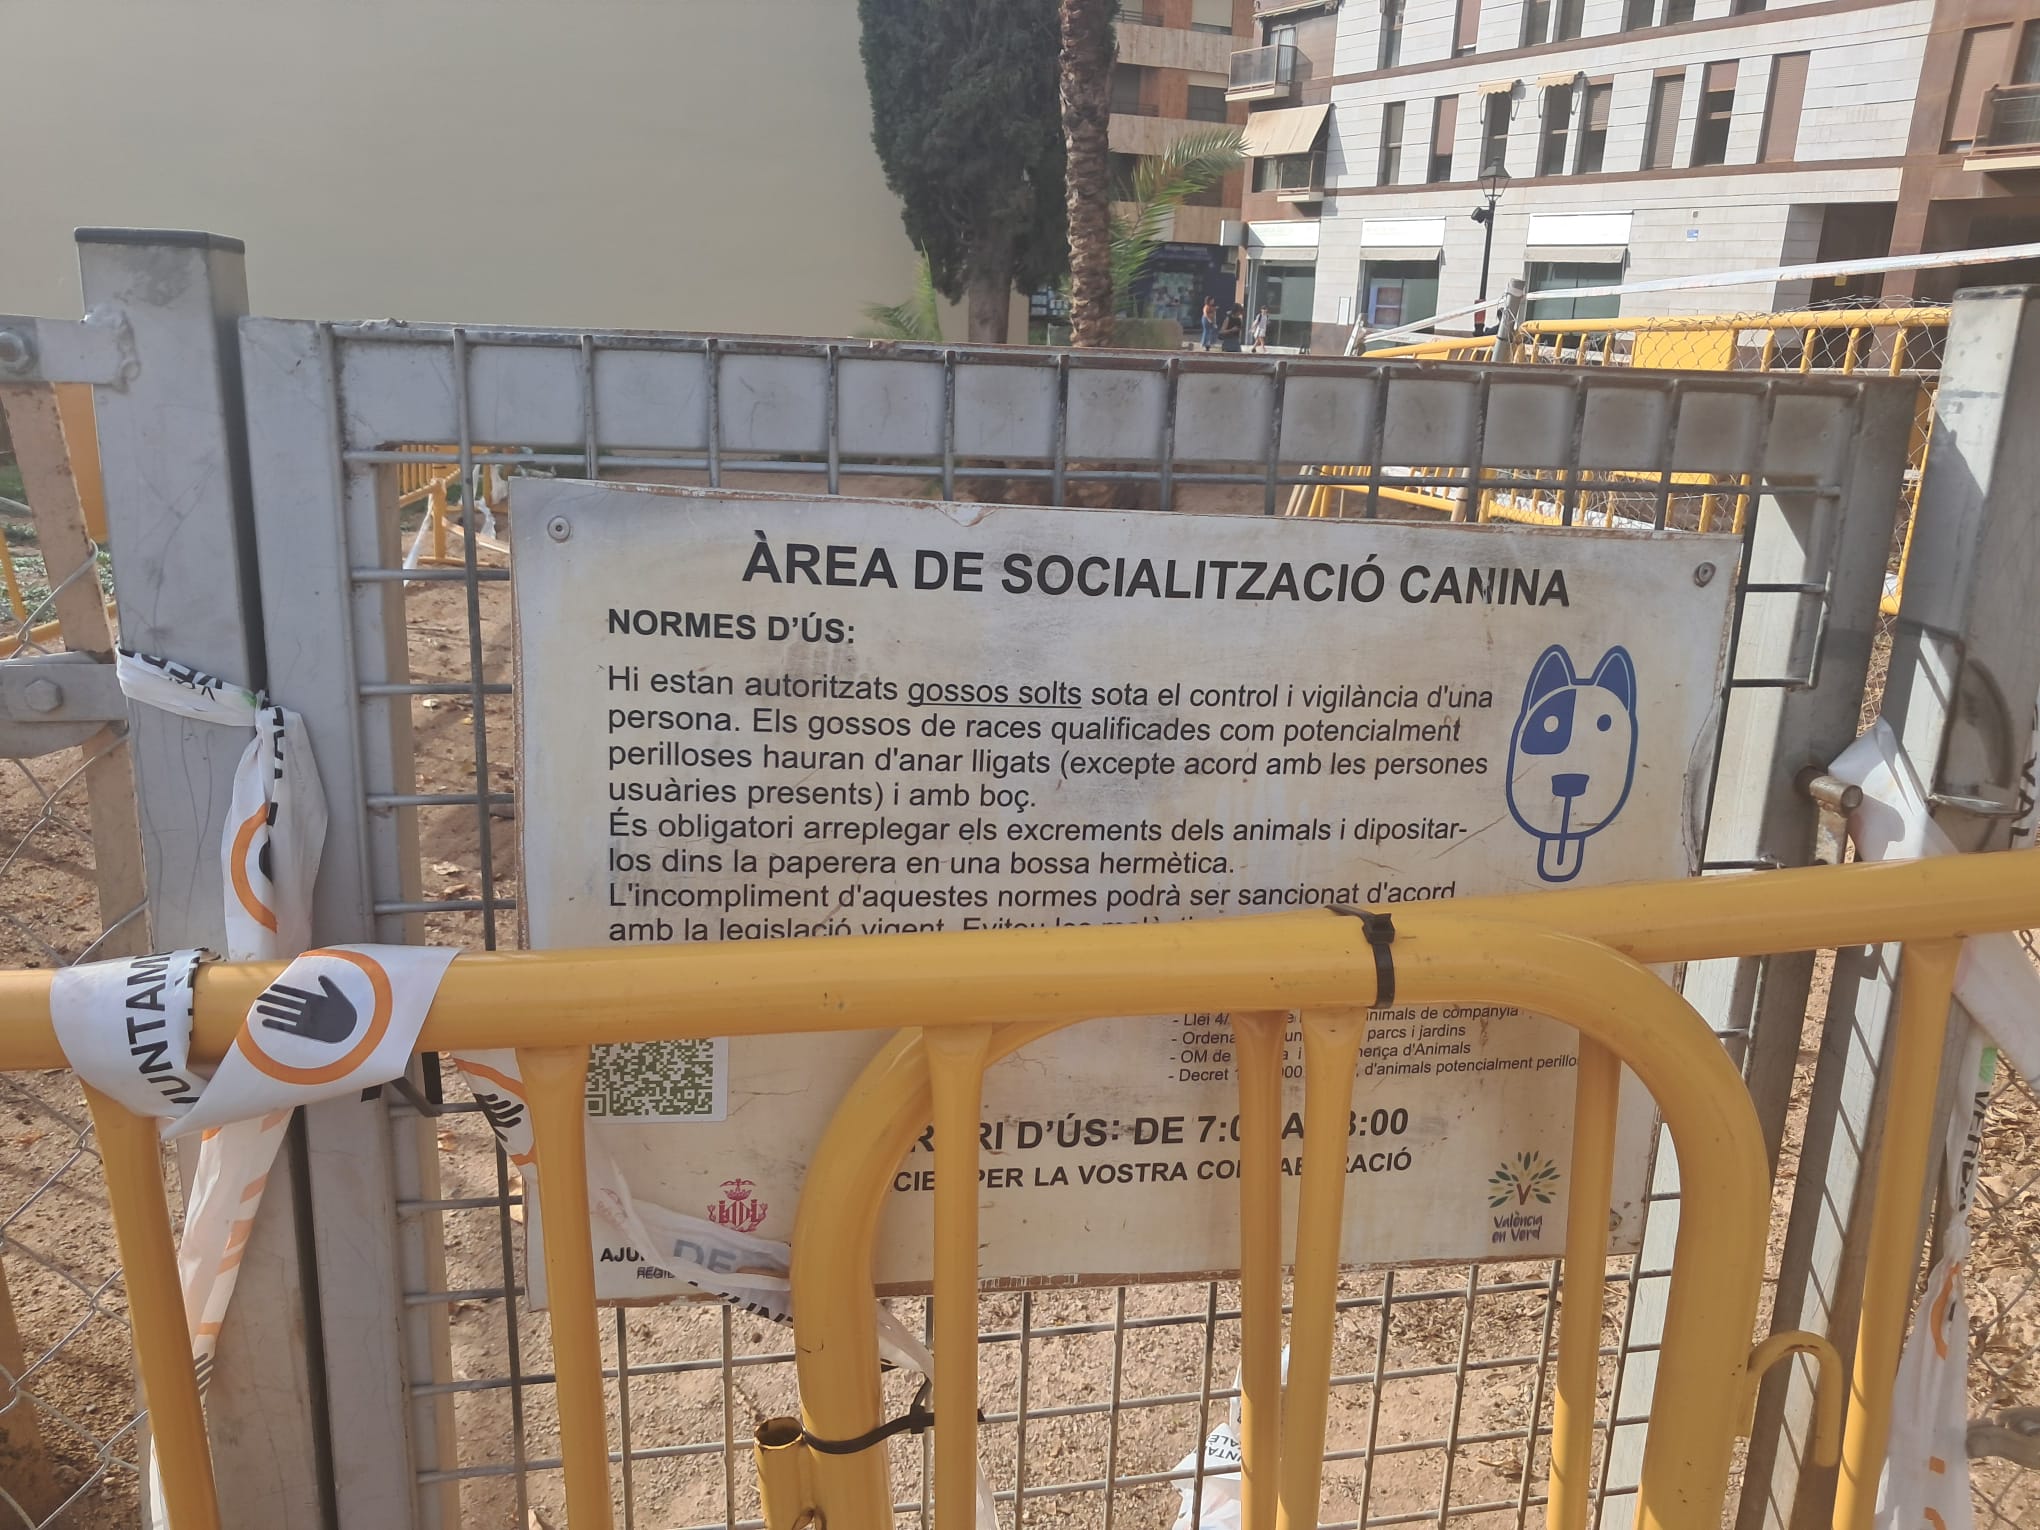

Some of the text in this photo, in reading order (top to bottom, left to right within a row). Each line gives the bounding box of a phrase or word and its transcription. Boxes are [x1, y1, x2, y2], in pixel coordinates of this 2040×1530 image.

[742, 530, 1569, 607] ÀREA DE SOCIALITZACIÓ CANINA
[609, 609, 756, 640] NORMES
[609, 665, 1492, 713] Hi estan autoritzats gossos solts sota el control i vigilància d'una
[609, 708, 1460, 747] persona. Els gossos de races qualificades com potencialment
[609, 741, 1487, 780] perilloses hauran d'anar lligats (excepte acord amb les persones
[609, 777, 1037, 813] usuàries presents) i amb boç.
[610, 807, 1470, 846] És obligatori arreplegar els excrements dels animals i dipositar-
[610, 848, 1235, 879] los dins la paperera en una bossa hermètica.
[610, 881, 1455, 912] L'incompliment d'aquestes normes podrà ser sancionat d'acord
[609, 917, 673, 941] amb
[685, 917, 708, 941] la
[1184, 1013, 1210, 1026] Llei
[1420, 1006, 1438, 1020] de
[1182, 1031, 1236, 1044] Ordena
[1368, 1028, 1407, 1042] parcs
[1418, 1023, 1466, 1041] jardins
[1179, 1068, 1228, 1081] Decret
[1365, 1060, 1431, 1076] d'animals
[1436, 1057, 1532, 1076] potencialment
[1537, 1053, 1577, 1071] perillo
[1181, 1050, 1207, 1063] OM
[1213, 1049, 1231, 1063] de
[1403, 1042, 1471, 1056] d'Animals
[1134, 1117, 1185, 1145] DE
[1281, 1112, 1304, 1140] A
[1034, 1166, 1069, 1187] LA
[1078, 1161, 1188, 1185] VOSTRA
